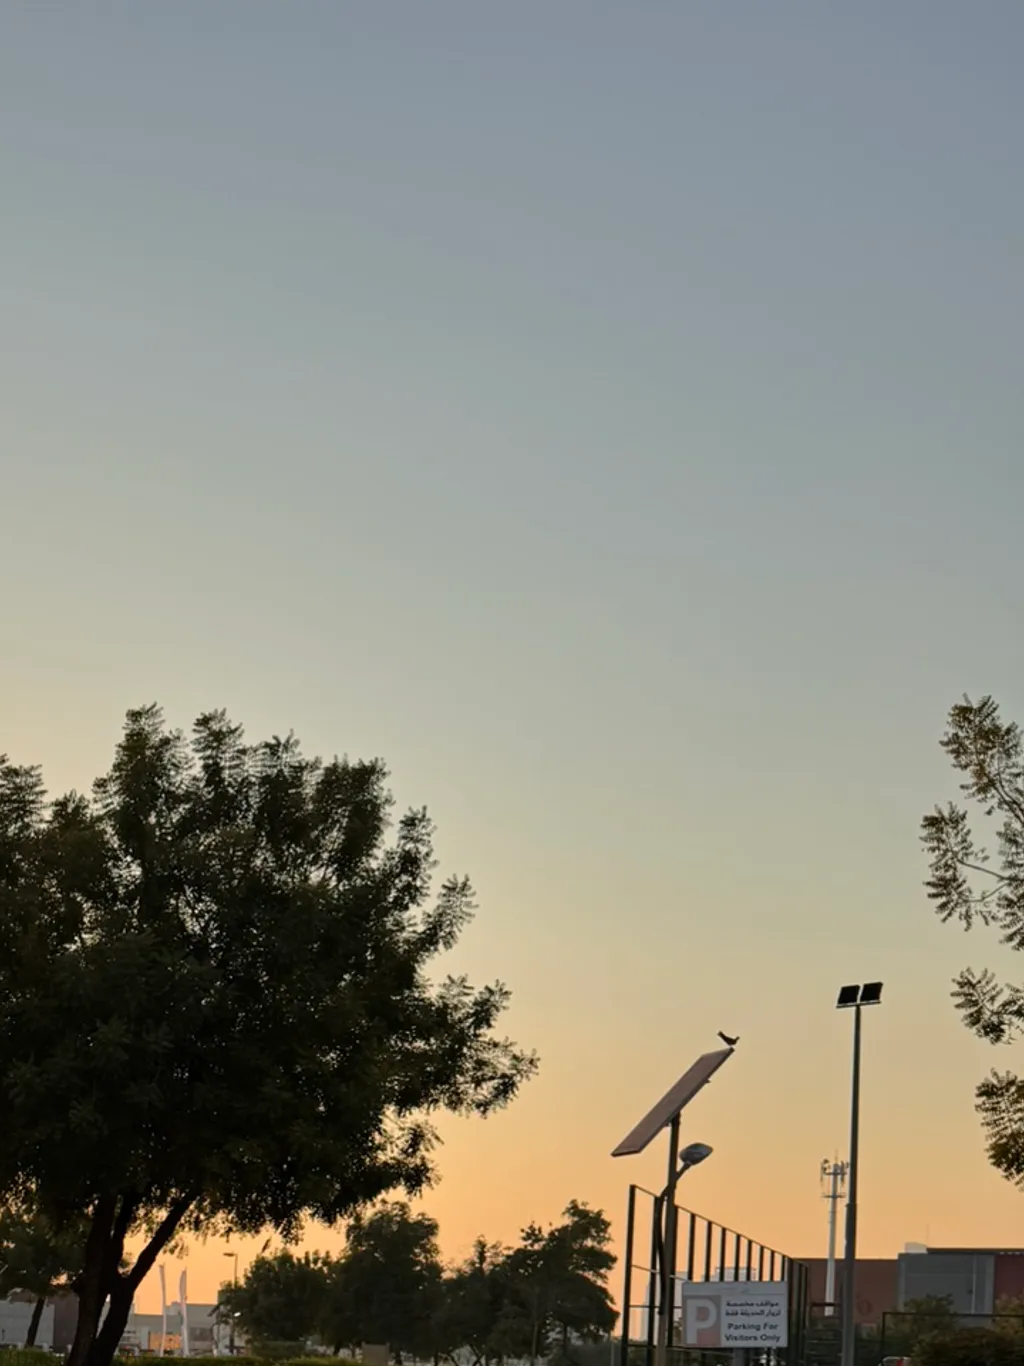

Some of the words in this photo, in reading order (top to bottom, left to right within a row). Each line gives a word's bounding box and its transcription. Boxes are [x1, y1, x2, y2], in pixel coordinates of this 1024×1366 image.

[686, 1299, 717, 1344] P
[727, 1323, 761, 1331] Parking
[763, 1322, 778, 1330] For
[725, 1333, 758, 1341] Visitors
[760, 1333, 781, 1343] Only
